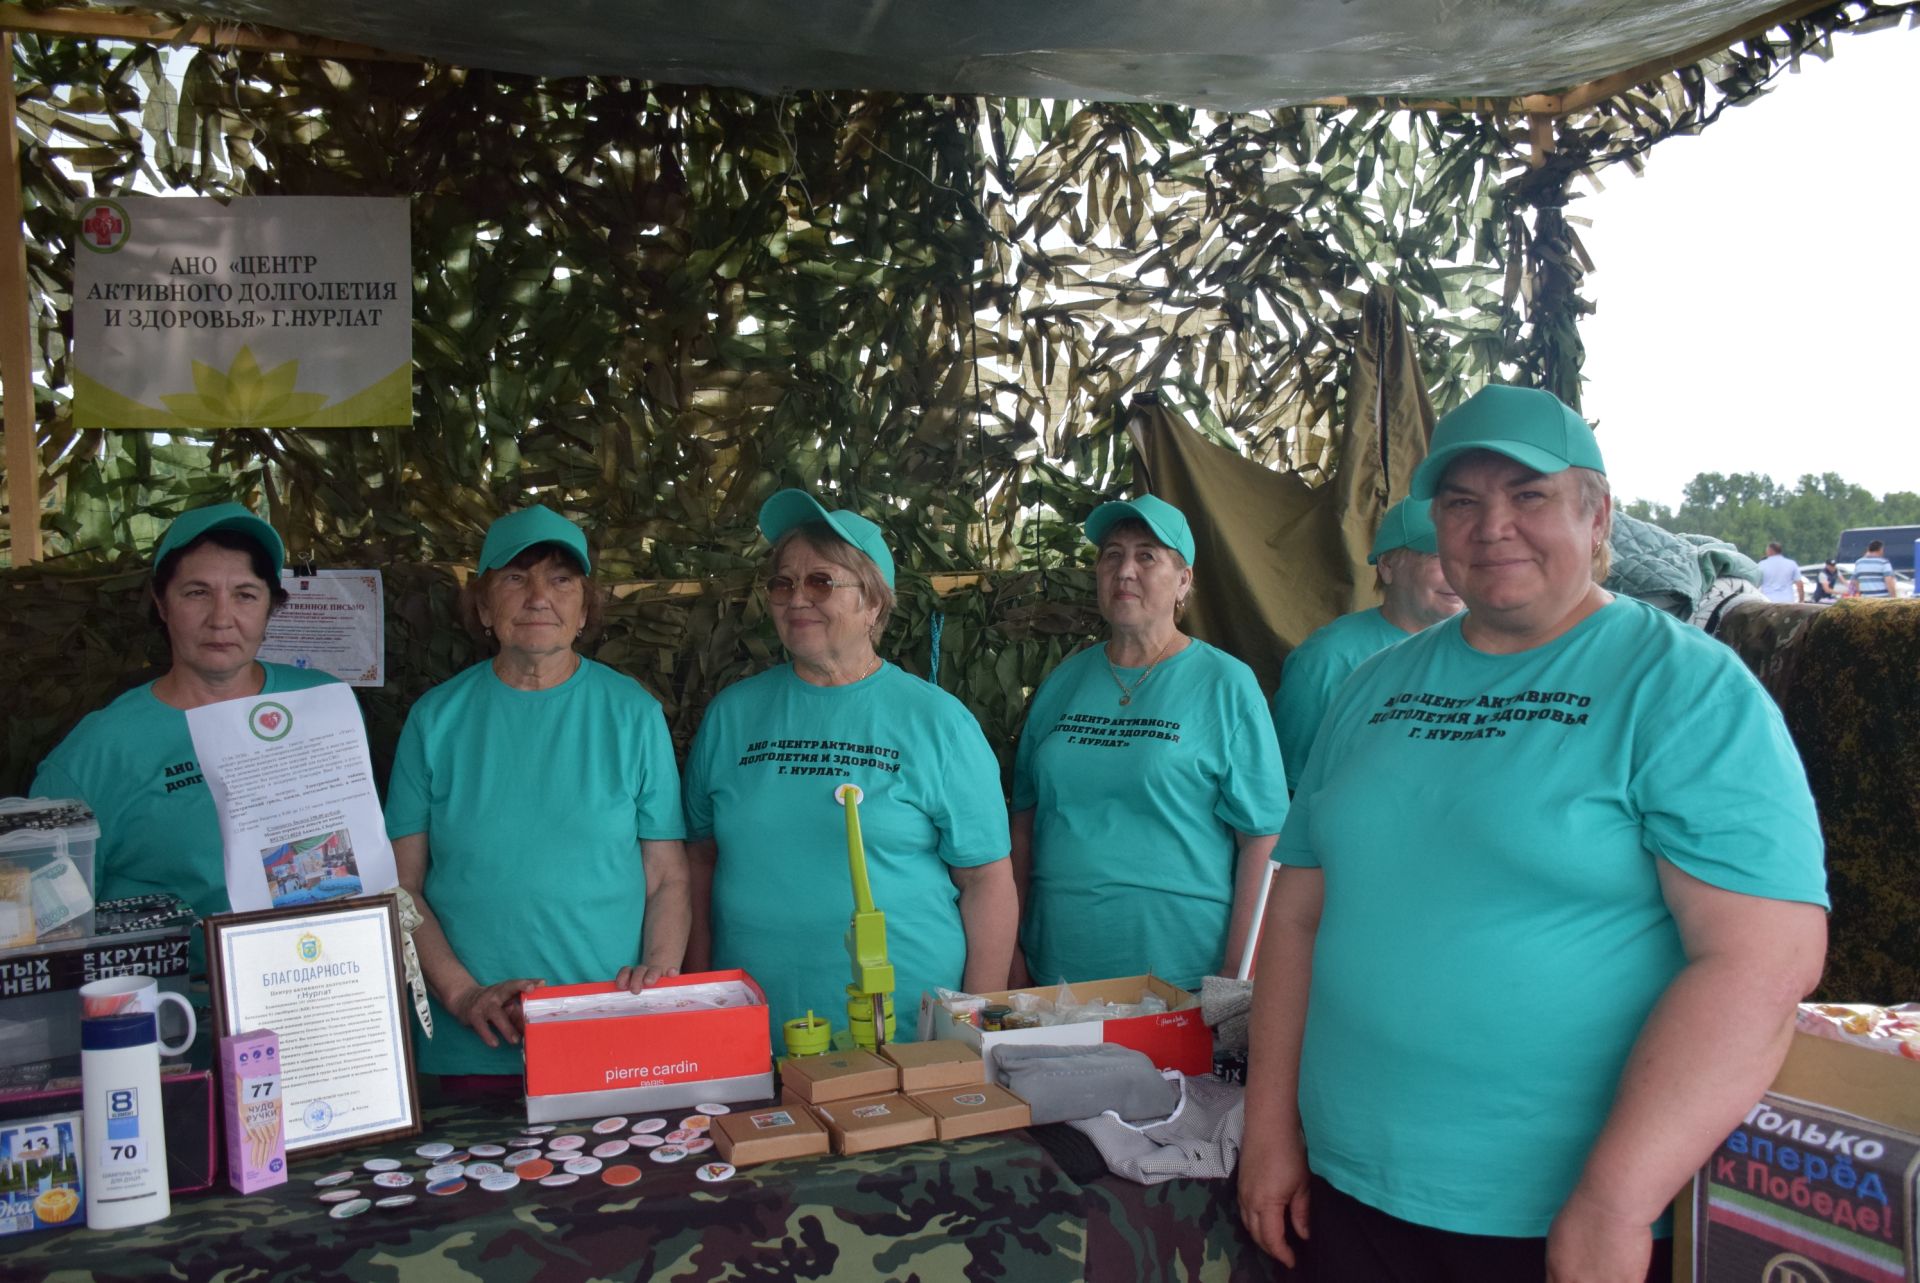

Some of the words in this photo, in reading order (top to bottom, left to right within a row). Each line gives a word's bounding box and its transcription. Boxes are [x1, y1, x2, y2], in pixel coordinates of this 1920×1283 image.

[169, 255, 217, 276] АНО
[229, 255, 317, 278] «ЦЕНТР
[86, 282, 233, 303] АКТИВНОГО
[238, 281, 398, 304] ДОЛГОЛЕТИЯ
[104, 309, 121, 328] И
[128, 309, 265, 331] ЗДОРОВЬЯ»
[271, 308, 383, 328] Г.НУРЛАТ
[1110, 718, 1181, 730] АКТИВНОГО
[1489, 708, 1589, 725] ЗДОРОВЬЯ
[1067, 736, 1076, 744] Г.
[1118, 729, 1180, 743] ЗДОРОВЬЯ
[1408, 727, 1422, 738] Г.
[1424, 727, 1506, 741] НУРЛАТ»
[747, 740, 768, 752] АНО
[770, 739, 819, 749] «ЦЕНТР
[820, 740, 899, 760] АКТИВНОГО
[164, 760, 195, 778] АНО
[739, 752, 818, 766] ДОЛГОЛЕТИЯ
[821, 754, 830, 763] И
[833, 754, 901, 773] ЗДОРОВЬЯ
[778, 766, 788, 774] Г.
[790, 766, 850, 777] НУРЛАТ»
[262, 960, 361, 987] БЛАГОДАРНОСТЬ
[0, 975, 51, 995] НЕЙ
[605, 1066, 649, 1084] pierre
[652, 1060, 699, 1077] cardin
[251, 1081, 274, 1098] 77
[111, 1090, 133, 1113] 8
[248, 1101, 274, 1114] ЧУДО
[246, 1108, 278, 1123] РУЧКИ
[1743, 1102, 1884, 1160] Только
[110, 1144, 137, 1161] 70
[1726, 1130, 1888, 1205] вперёд
[1747, 1160, 1893, 1239] Победе!
